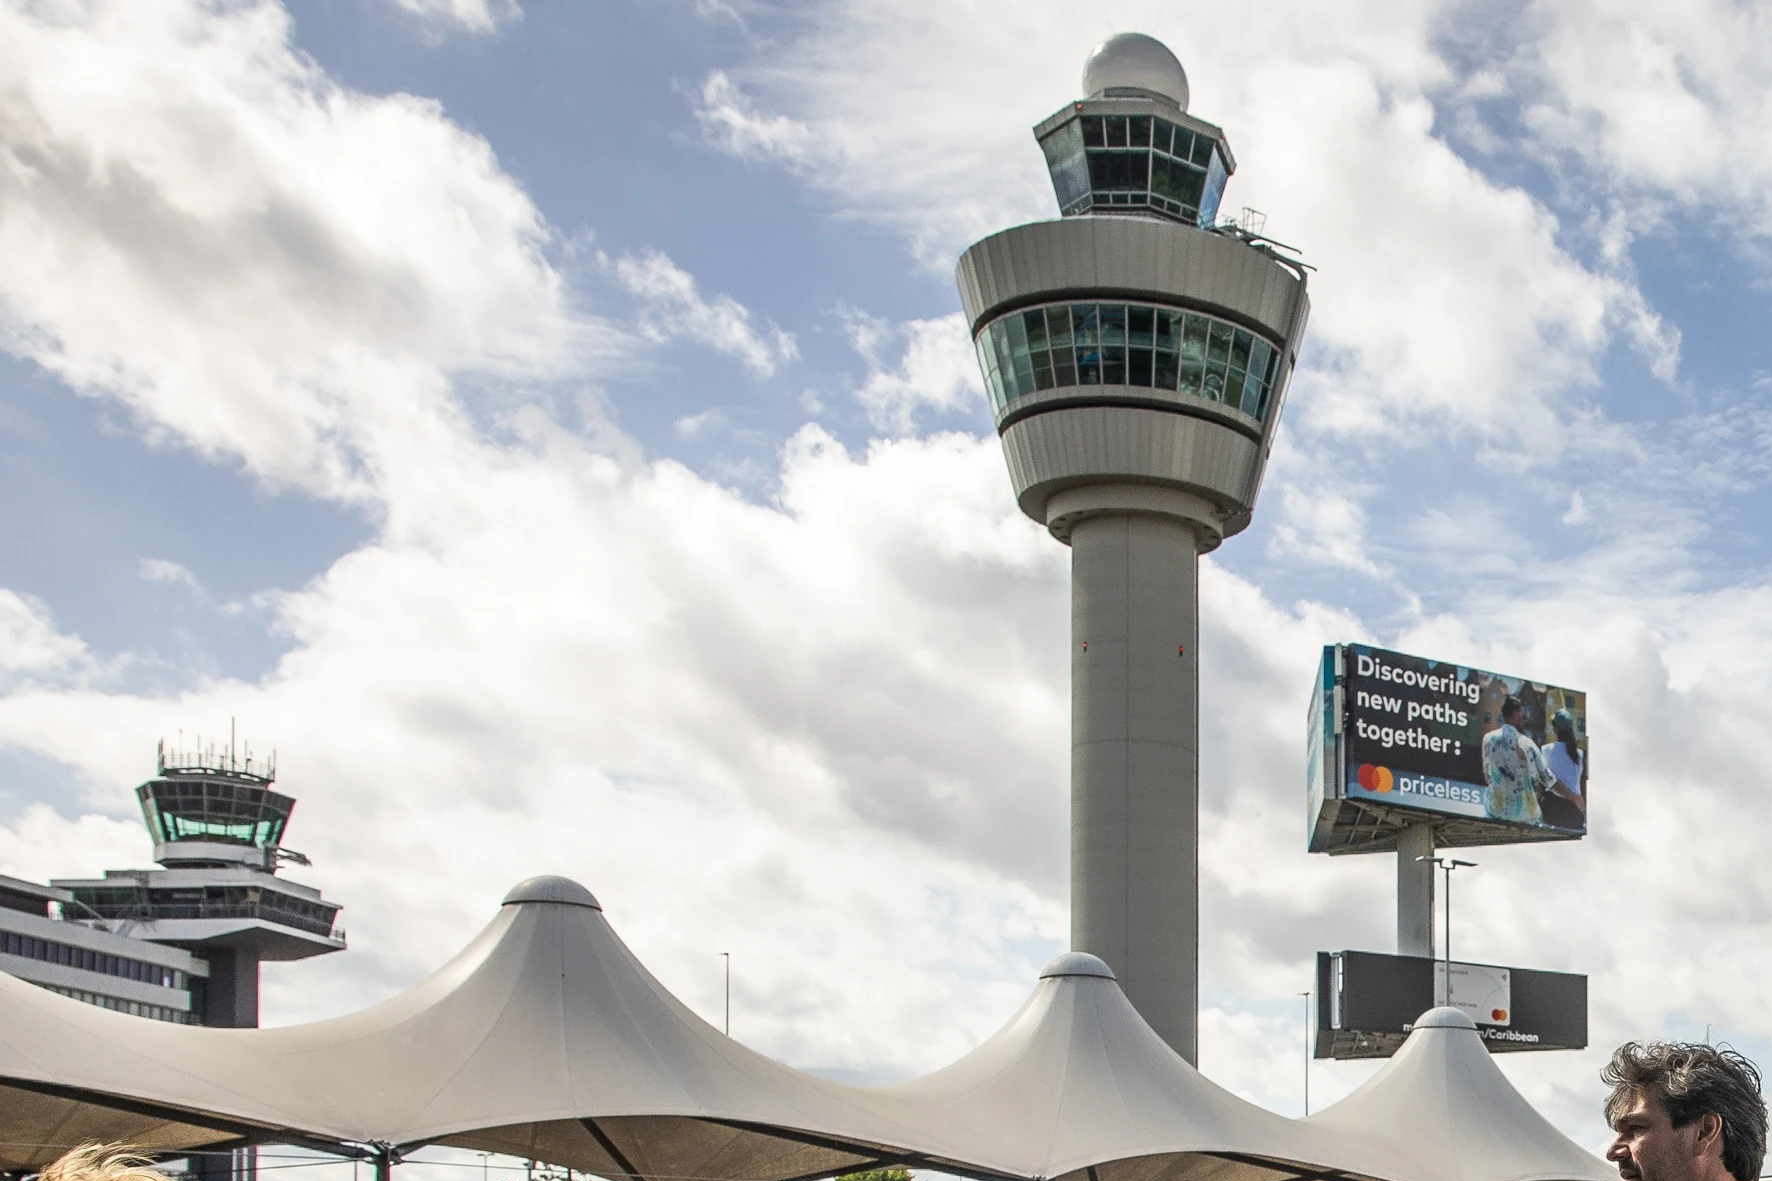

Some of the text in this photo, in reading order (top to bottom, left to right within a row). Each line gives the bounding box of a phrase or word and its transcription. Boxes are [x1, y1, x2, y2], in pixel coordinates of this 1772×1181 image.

[1357, 654, 1480, 704] Discovering
[1357, 691, 1468, 726] new paths
[1400, 775, 1480, 802] priceless
